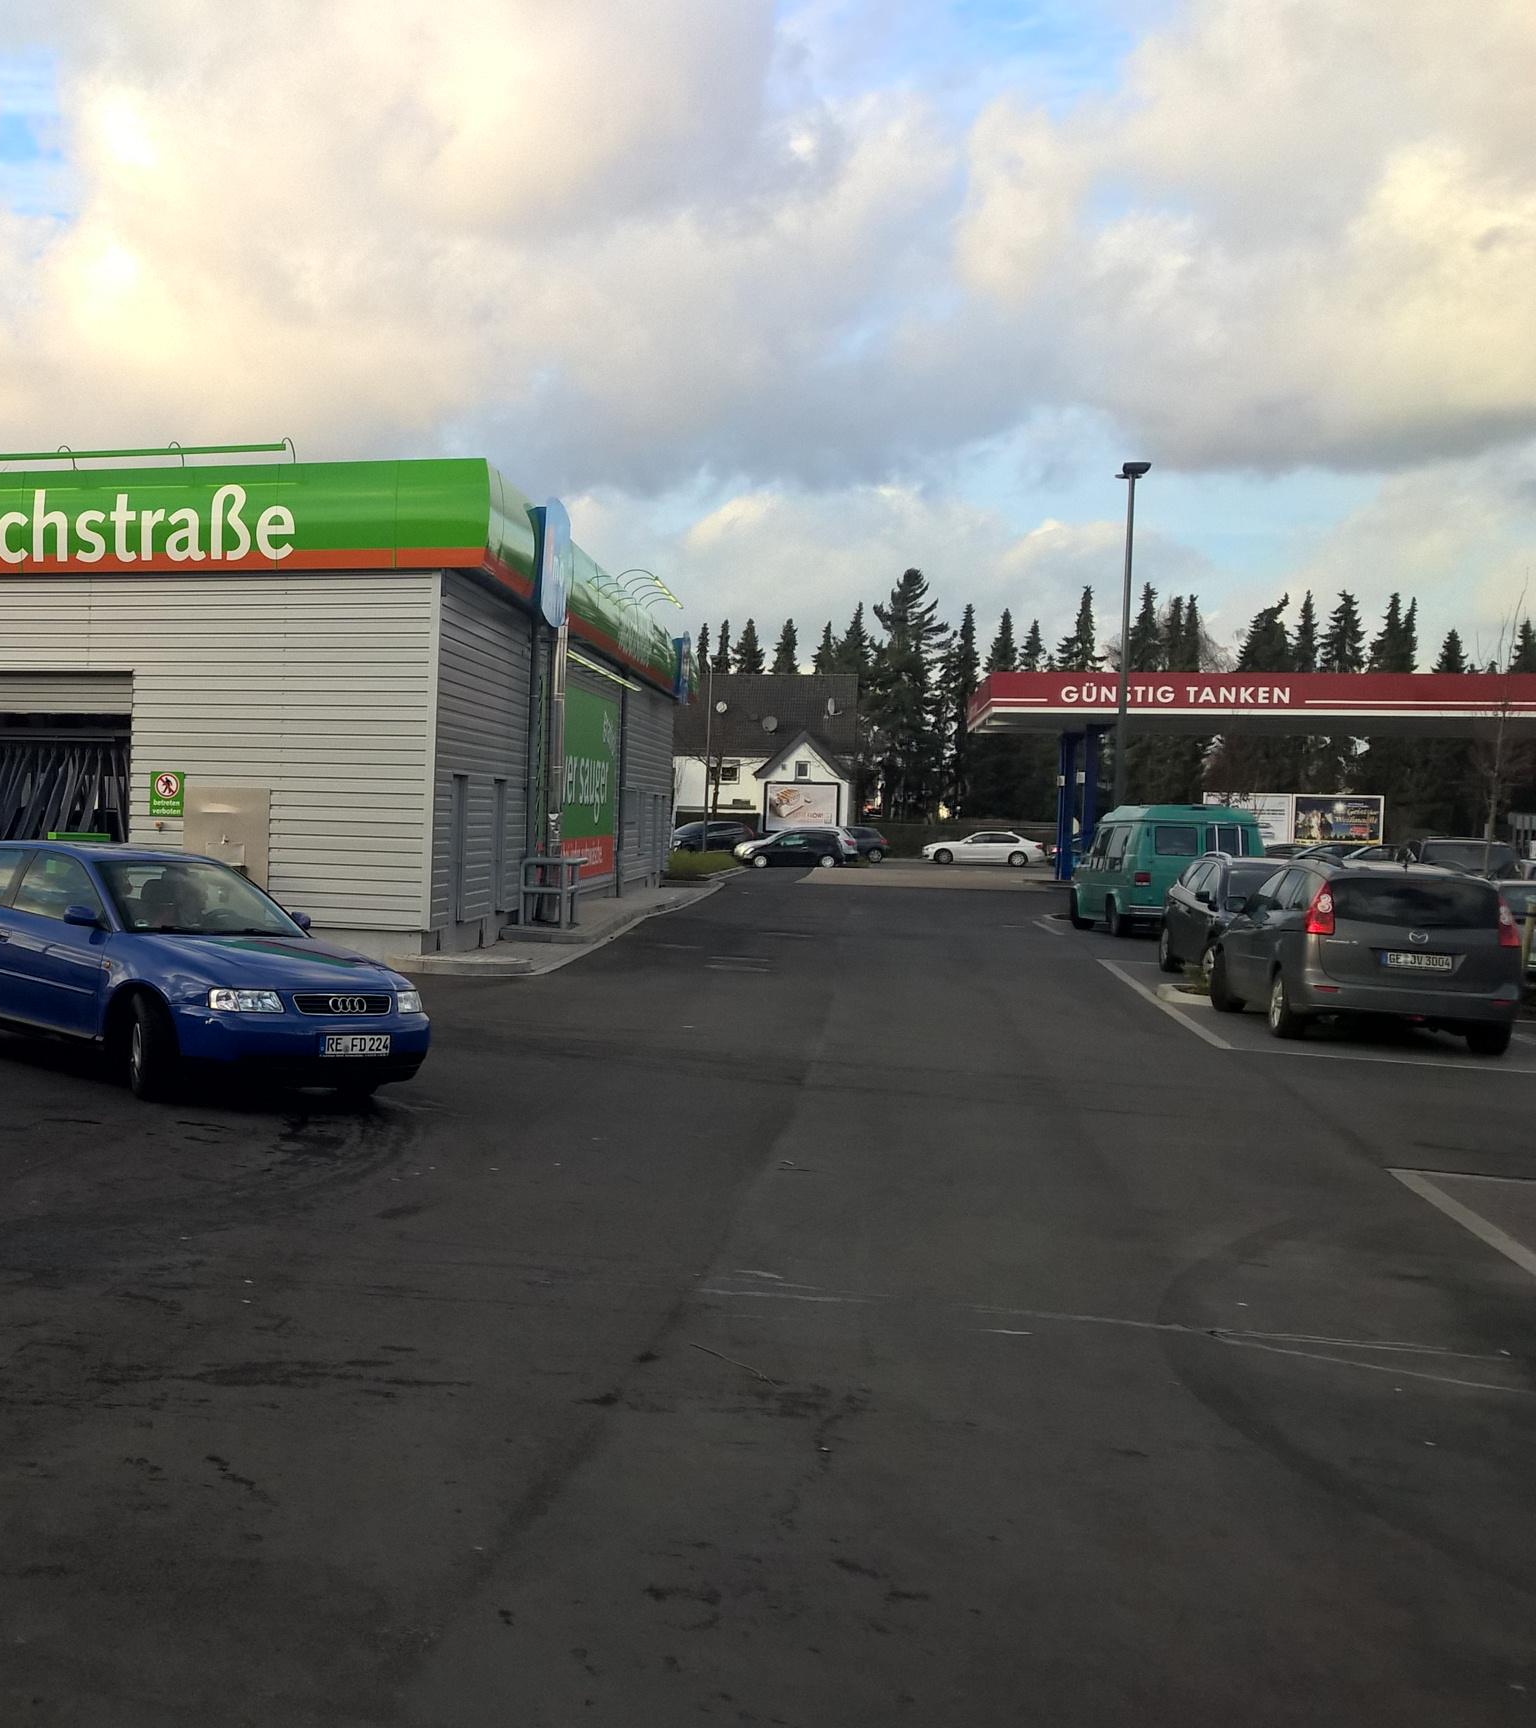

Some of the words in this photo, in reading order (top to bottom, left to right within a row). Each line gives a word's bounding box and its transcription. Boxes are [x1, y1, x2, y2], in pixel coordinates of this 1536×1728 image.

[1186, 686, 1291, 704] TANKEN
[579, 757, 609, 824] sauger
[152, 799, 181, 807] betreten
[151, 807, 181, 815] verboten
[1389, 953, 1401, 965] GE
[1425, 955, 1451, 968] 3004
[326, 1037, 343, 1052] RE
[350, 1037, 367, 1052] FD
[368, 1037, 389, 1052] 224
